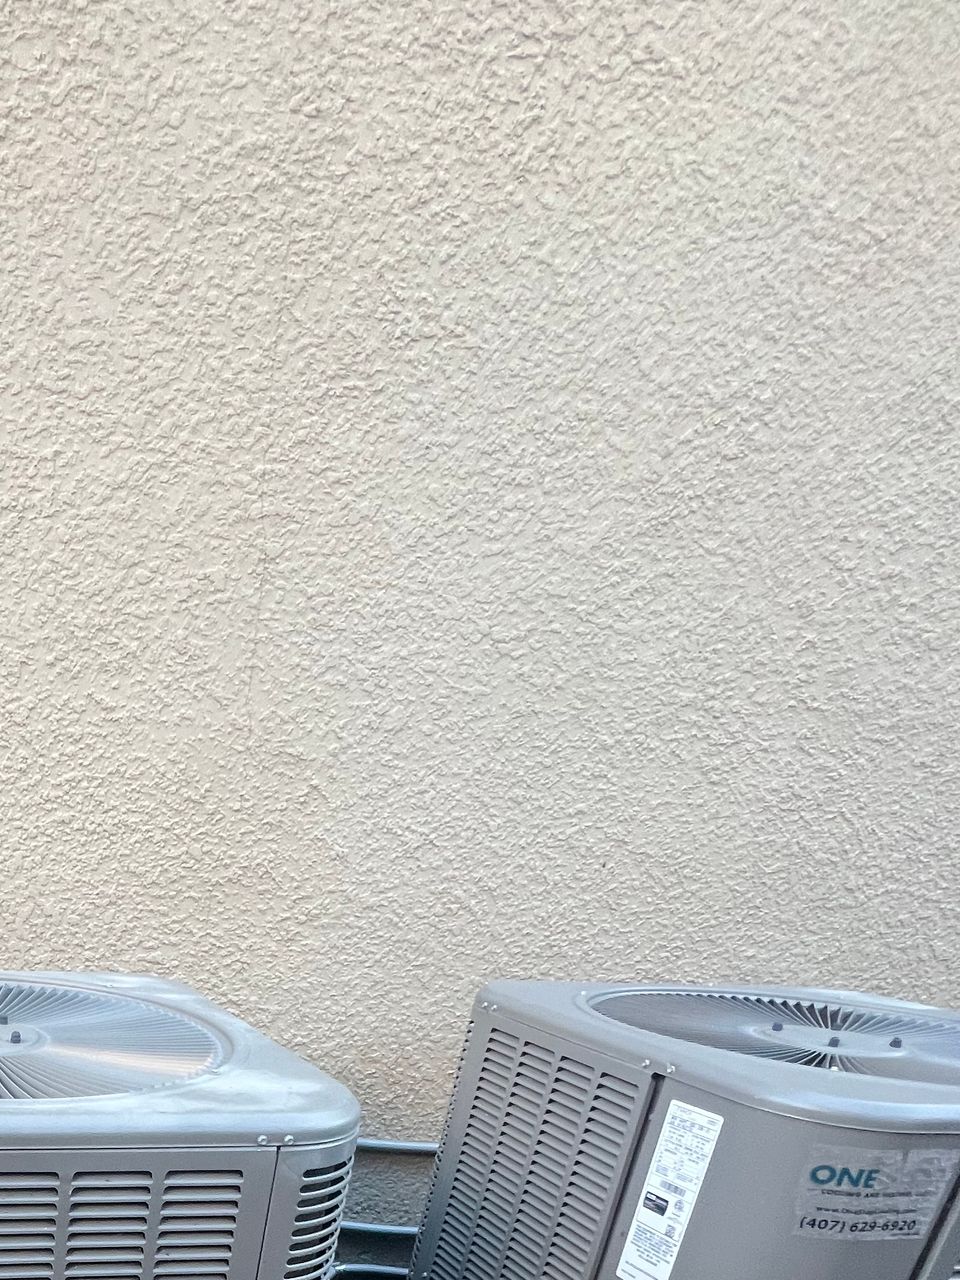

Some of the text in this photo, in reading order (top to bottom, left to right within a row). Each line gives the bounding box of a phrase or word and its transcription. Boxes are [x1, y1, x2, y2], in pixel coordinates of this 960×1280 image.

[810, 1164, 881, 1189] ONE
[800, 1216, 917, 1233] (407) 629-6920
